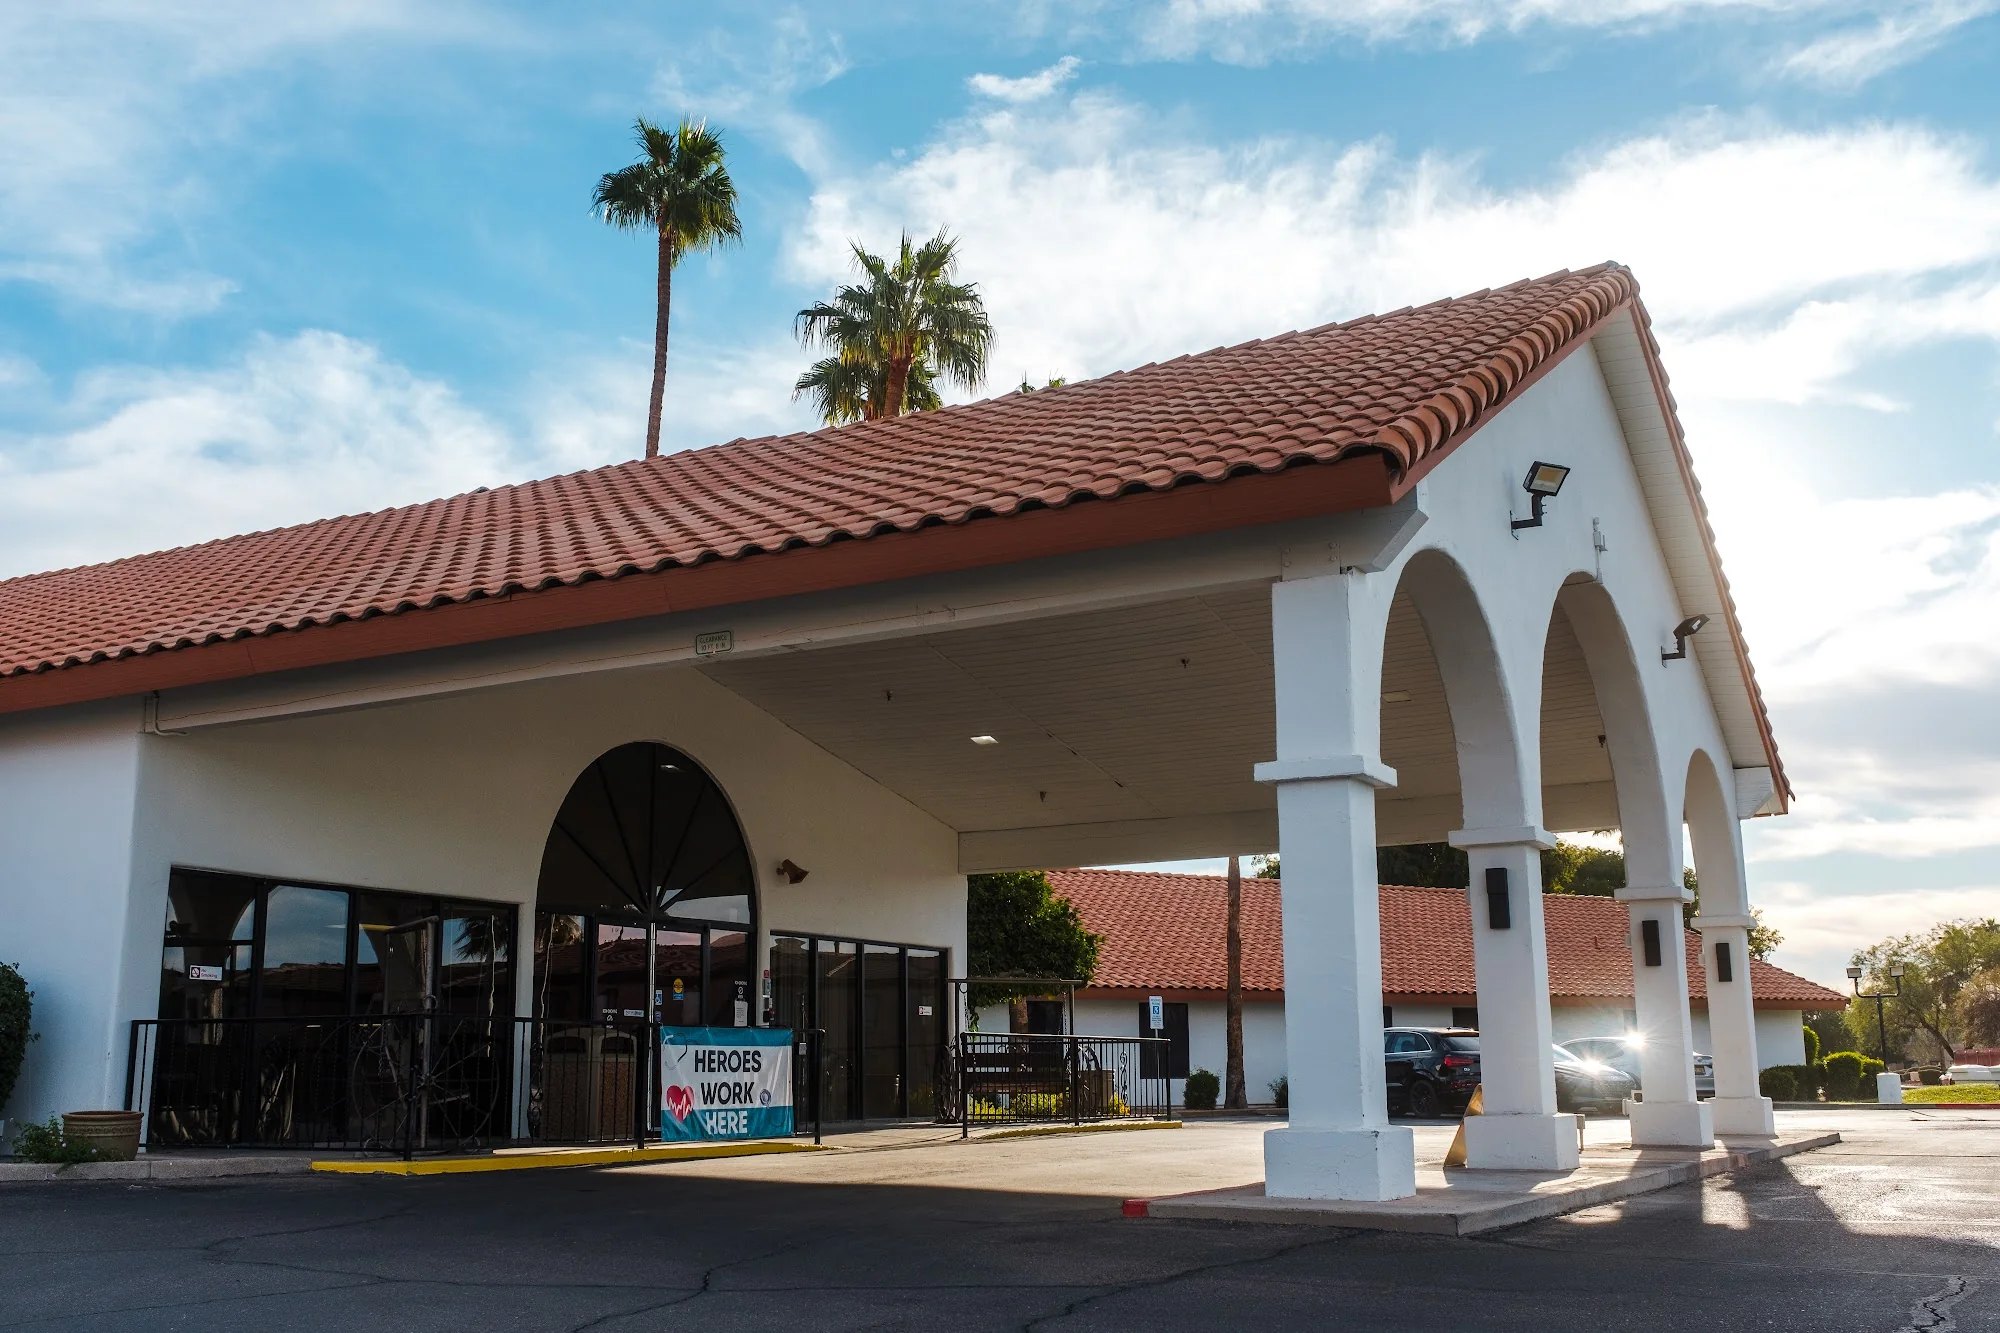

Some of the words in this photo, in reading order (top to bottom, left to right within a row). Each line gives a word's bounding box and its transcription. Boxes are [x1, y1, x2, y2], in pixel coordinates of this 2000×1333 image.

[694, 1050, 762, 1073] HEROES
[701, 1082, 755, 1105] WORK
[706, 1111, 748, 1135] HERE
